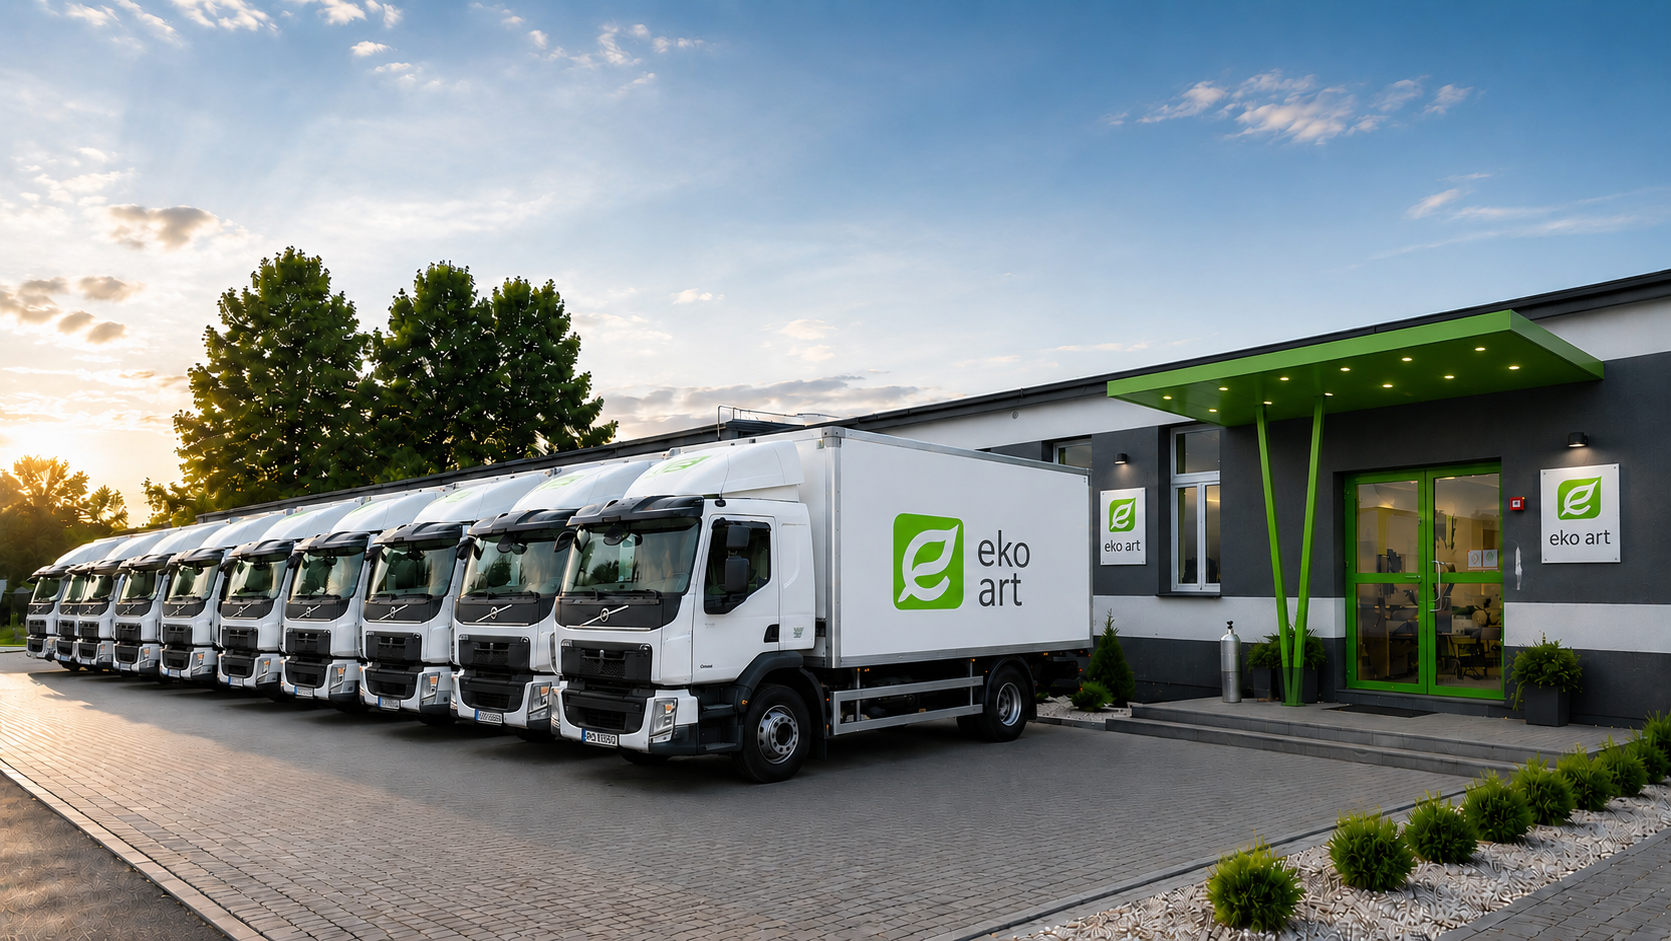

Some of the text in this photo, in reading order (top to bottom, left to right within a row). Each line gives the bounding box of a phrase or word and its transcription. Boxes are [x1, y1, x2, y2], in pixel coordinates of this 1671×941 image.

[977, 529, 1031, 569] eko
[1104, 539, 1141, 553] eko art
[1550, 529, 1611, 546] eko art
[978, 572, 1023, 607] art
